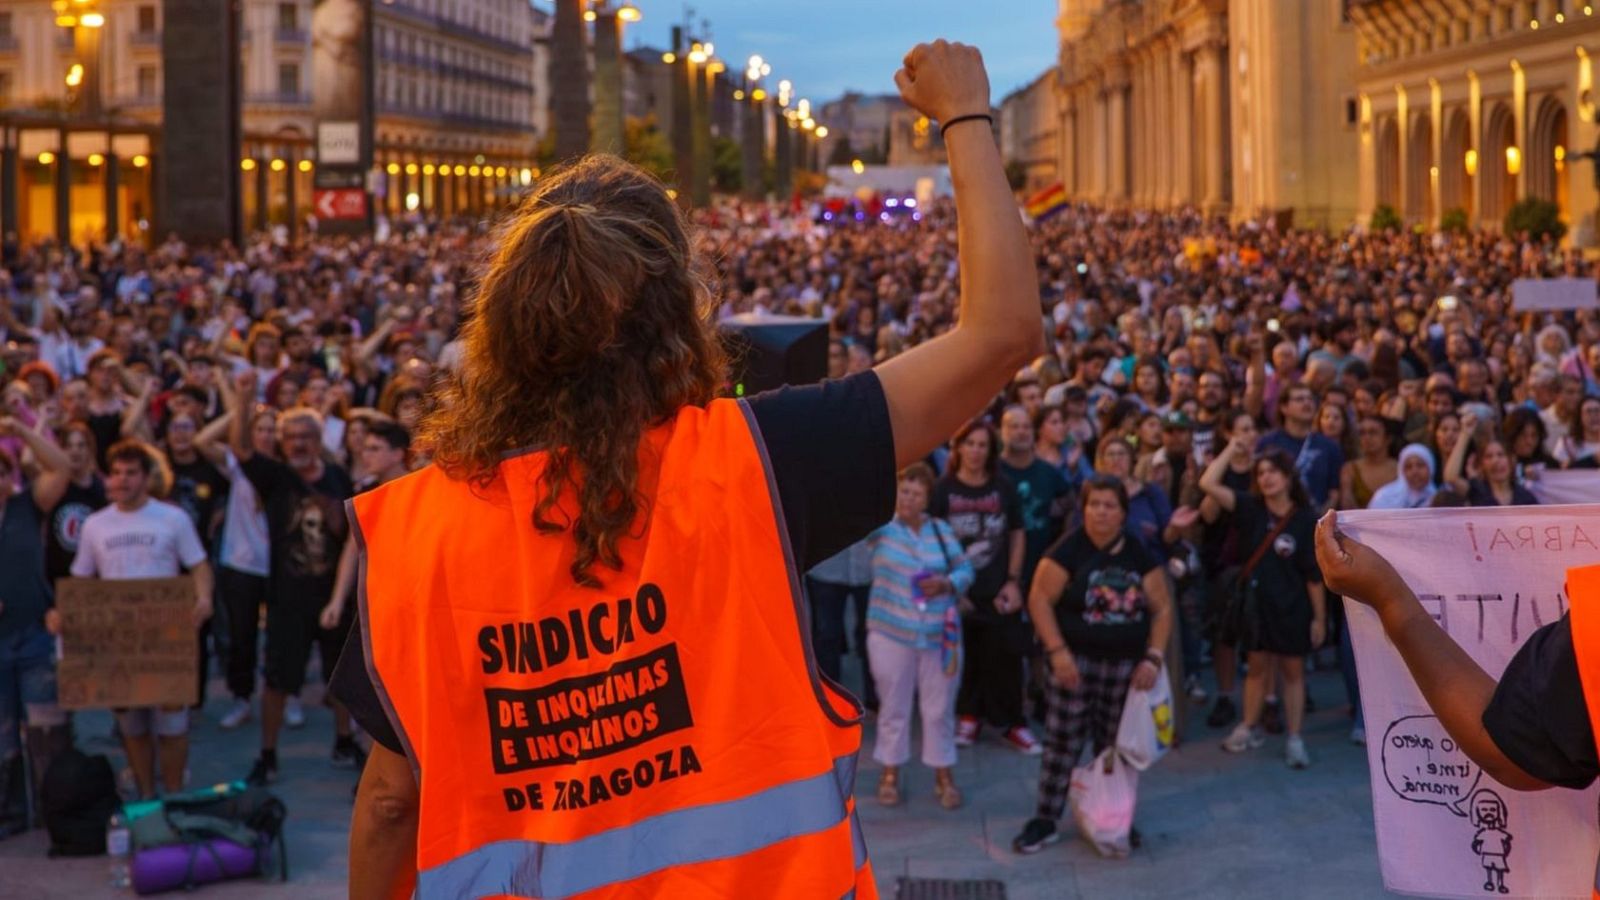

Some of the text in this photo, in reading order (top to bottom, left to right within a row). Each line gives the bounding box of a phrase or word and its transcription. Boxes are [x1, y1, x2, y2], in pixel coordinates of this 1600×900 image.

[499, 700, 529, 728] DE
[501, 739, 518, 765] E
[503, 745, 703, 812] DE ZRAGOZA
